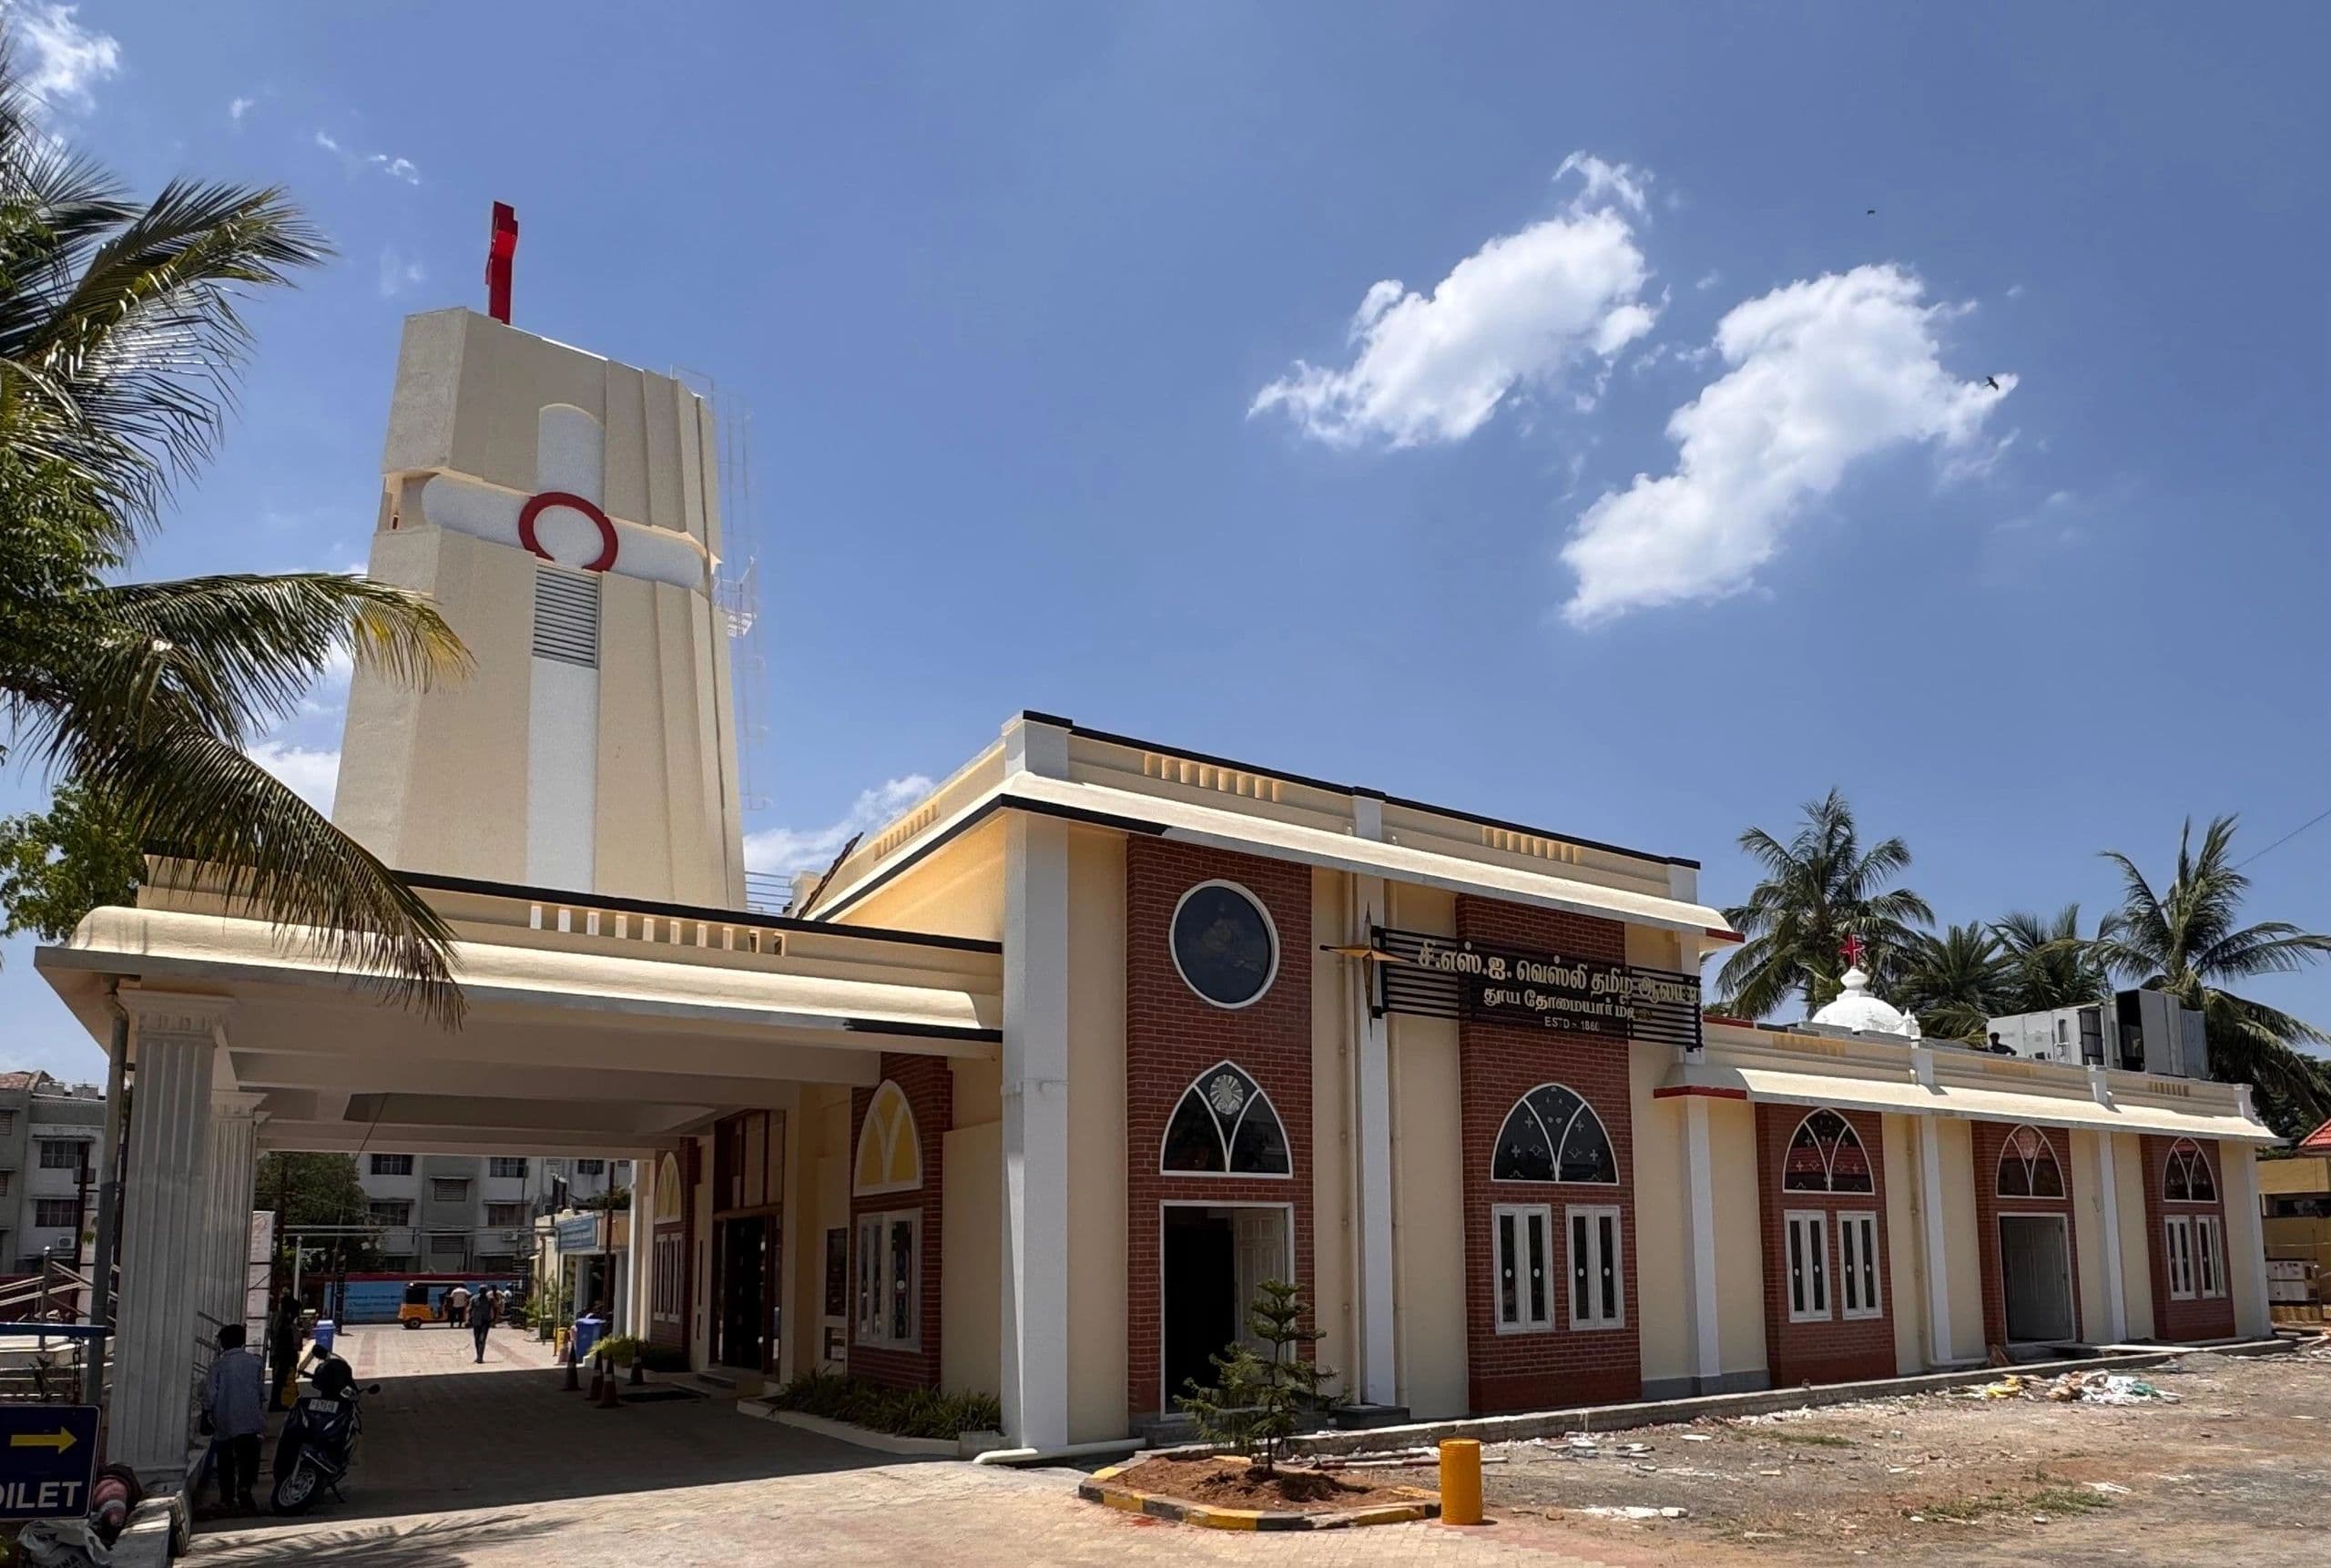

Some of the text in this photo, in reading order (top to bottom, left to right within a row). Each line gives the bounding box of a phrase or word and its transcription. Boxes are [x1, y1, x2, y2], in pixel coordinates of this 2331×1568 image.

[1516, 955, 1588, 990] வெஸ்லி
[1482, 987, 1521, 1007] தூய
[1523, 989, 1613, 1017] தோமையார்
[1544, 1015, 1571, 1029] ESTD
[0, 1481, 82, 1509] ILET
